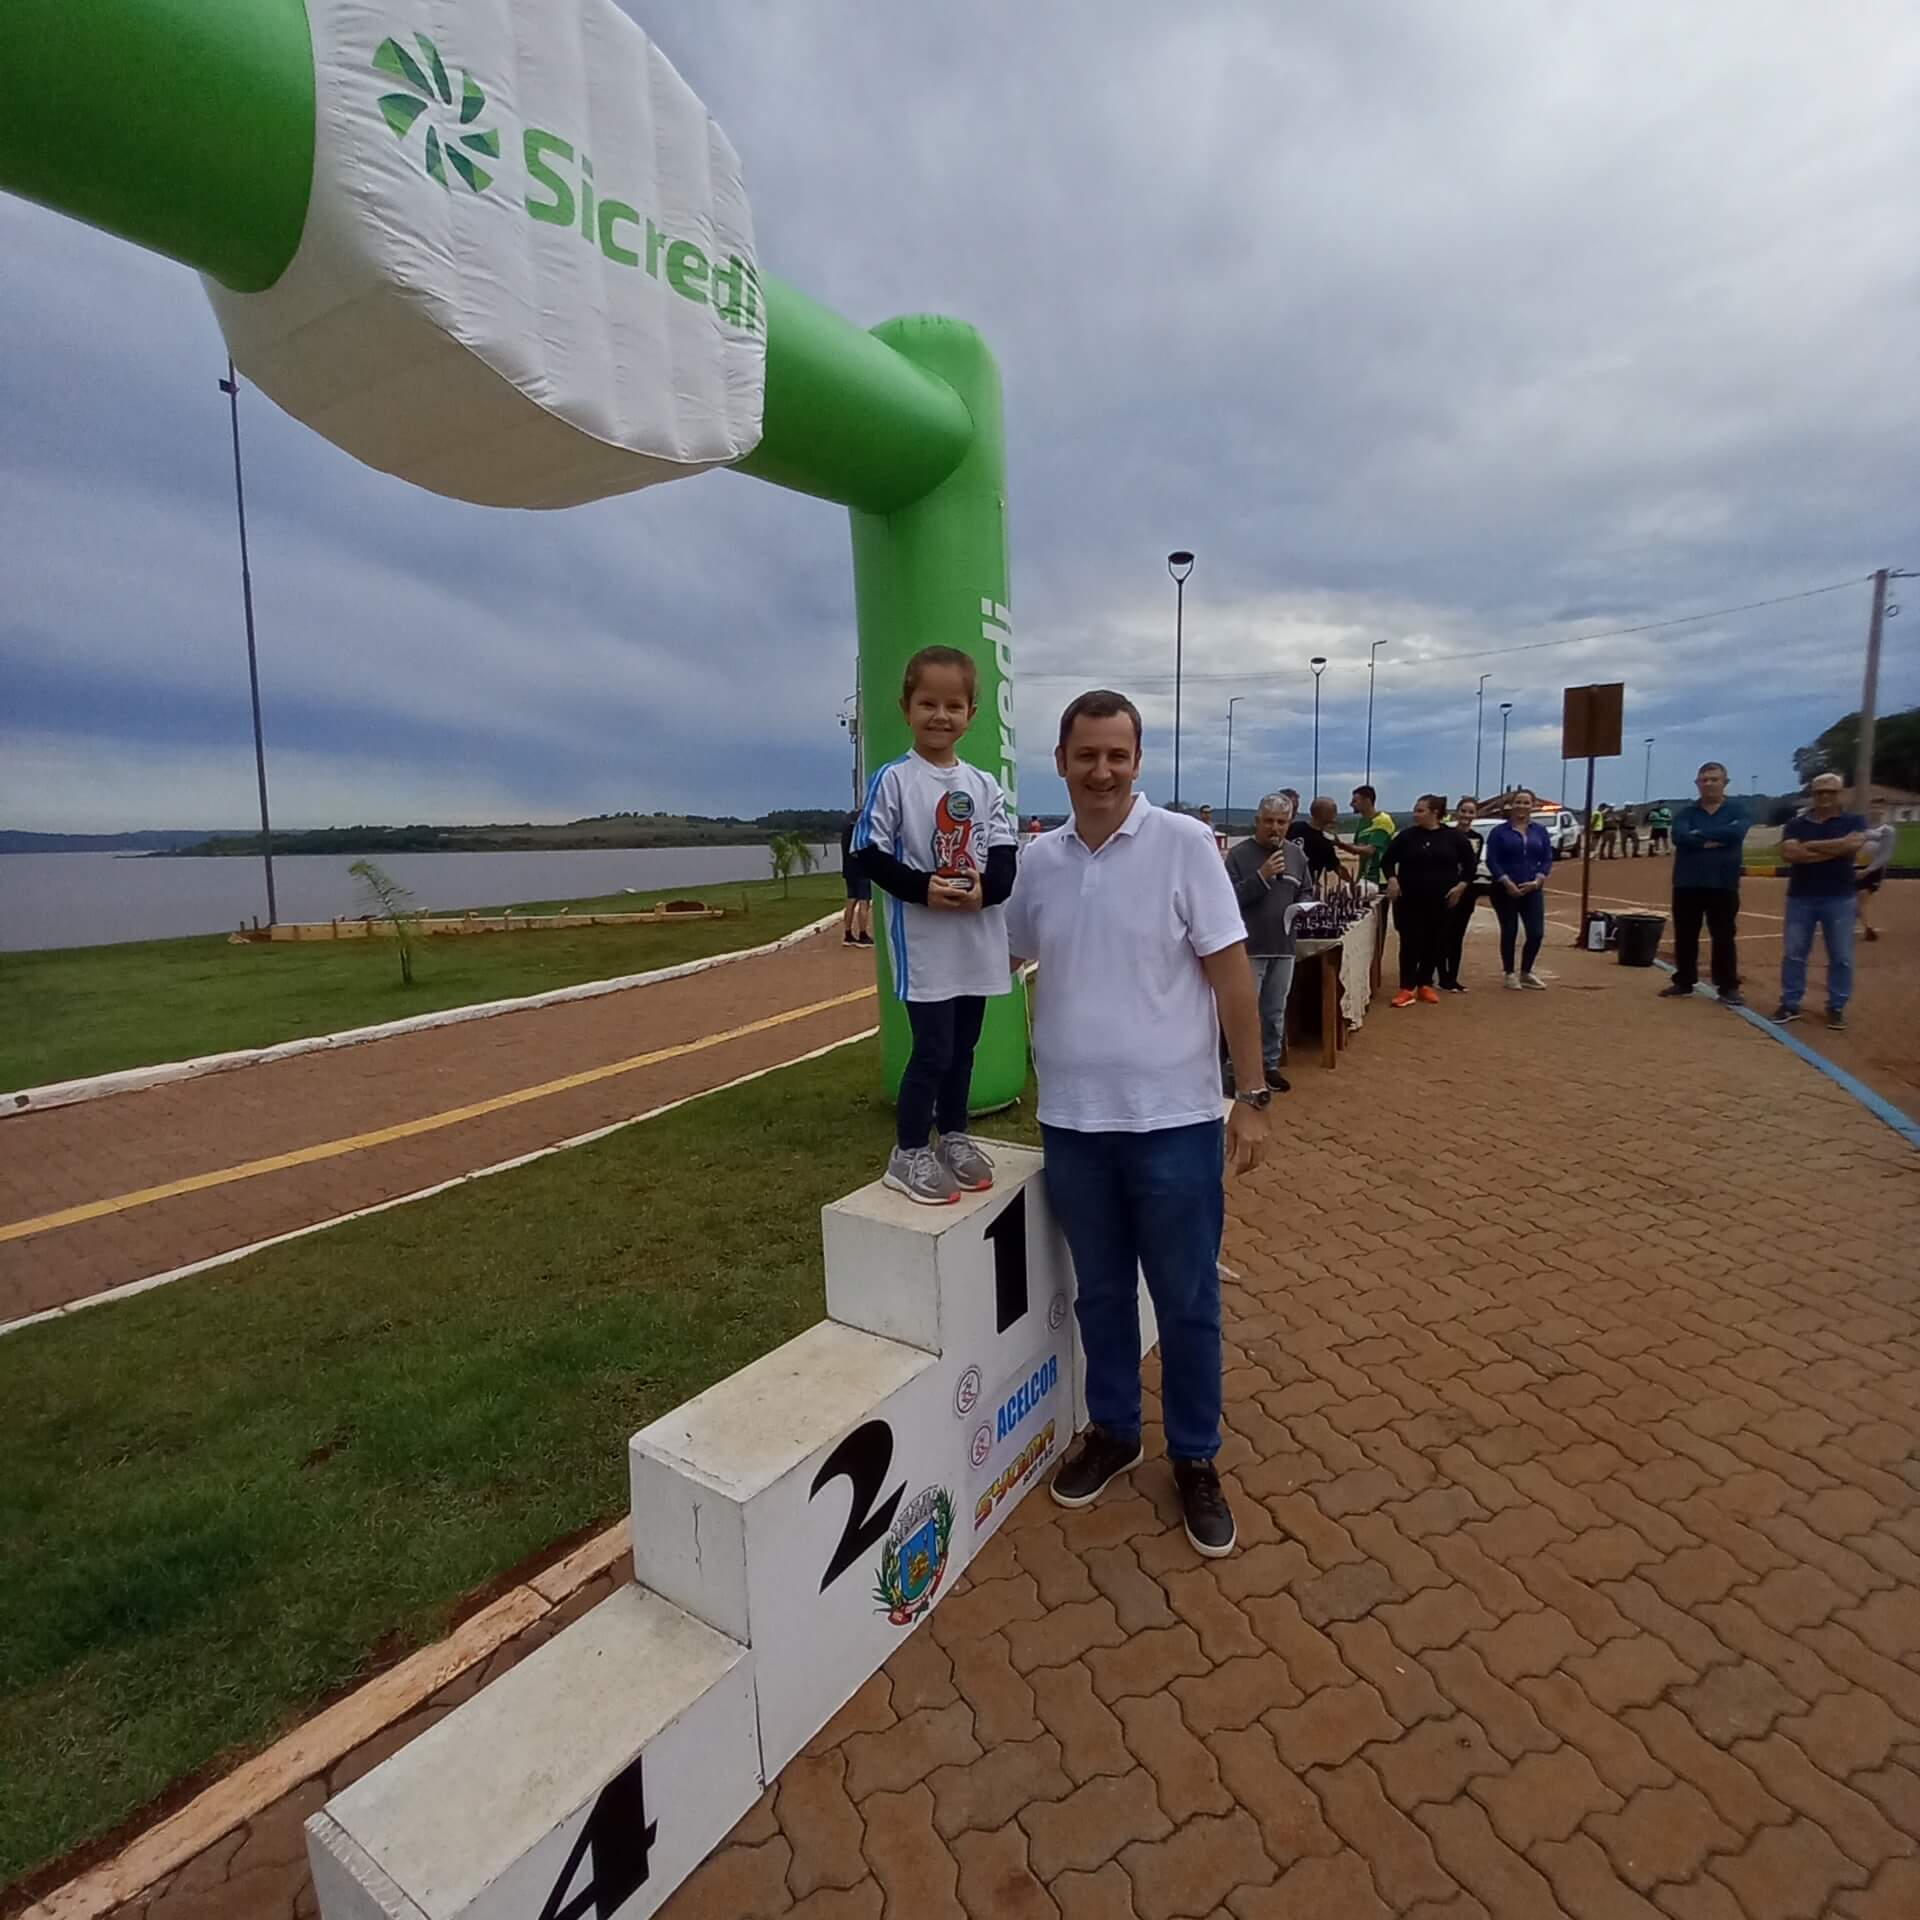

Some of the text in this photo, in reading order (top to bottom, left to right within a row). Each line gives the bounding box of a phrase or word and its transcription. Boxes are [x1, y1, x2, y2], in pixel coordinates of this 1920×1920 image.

[522, 128, 757, 336] Sicredi
[983, 1184, 1029, 1335] 1
[997, 1354, 1057, 1443] ACELCOR
[808, 1418, 908, 1595] 2
[537, 1753, 658, 1920] 4
